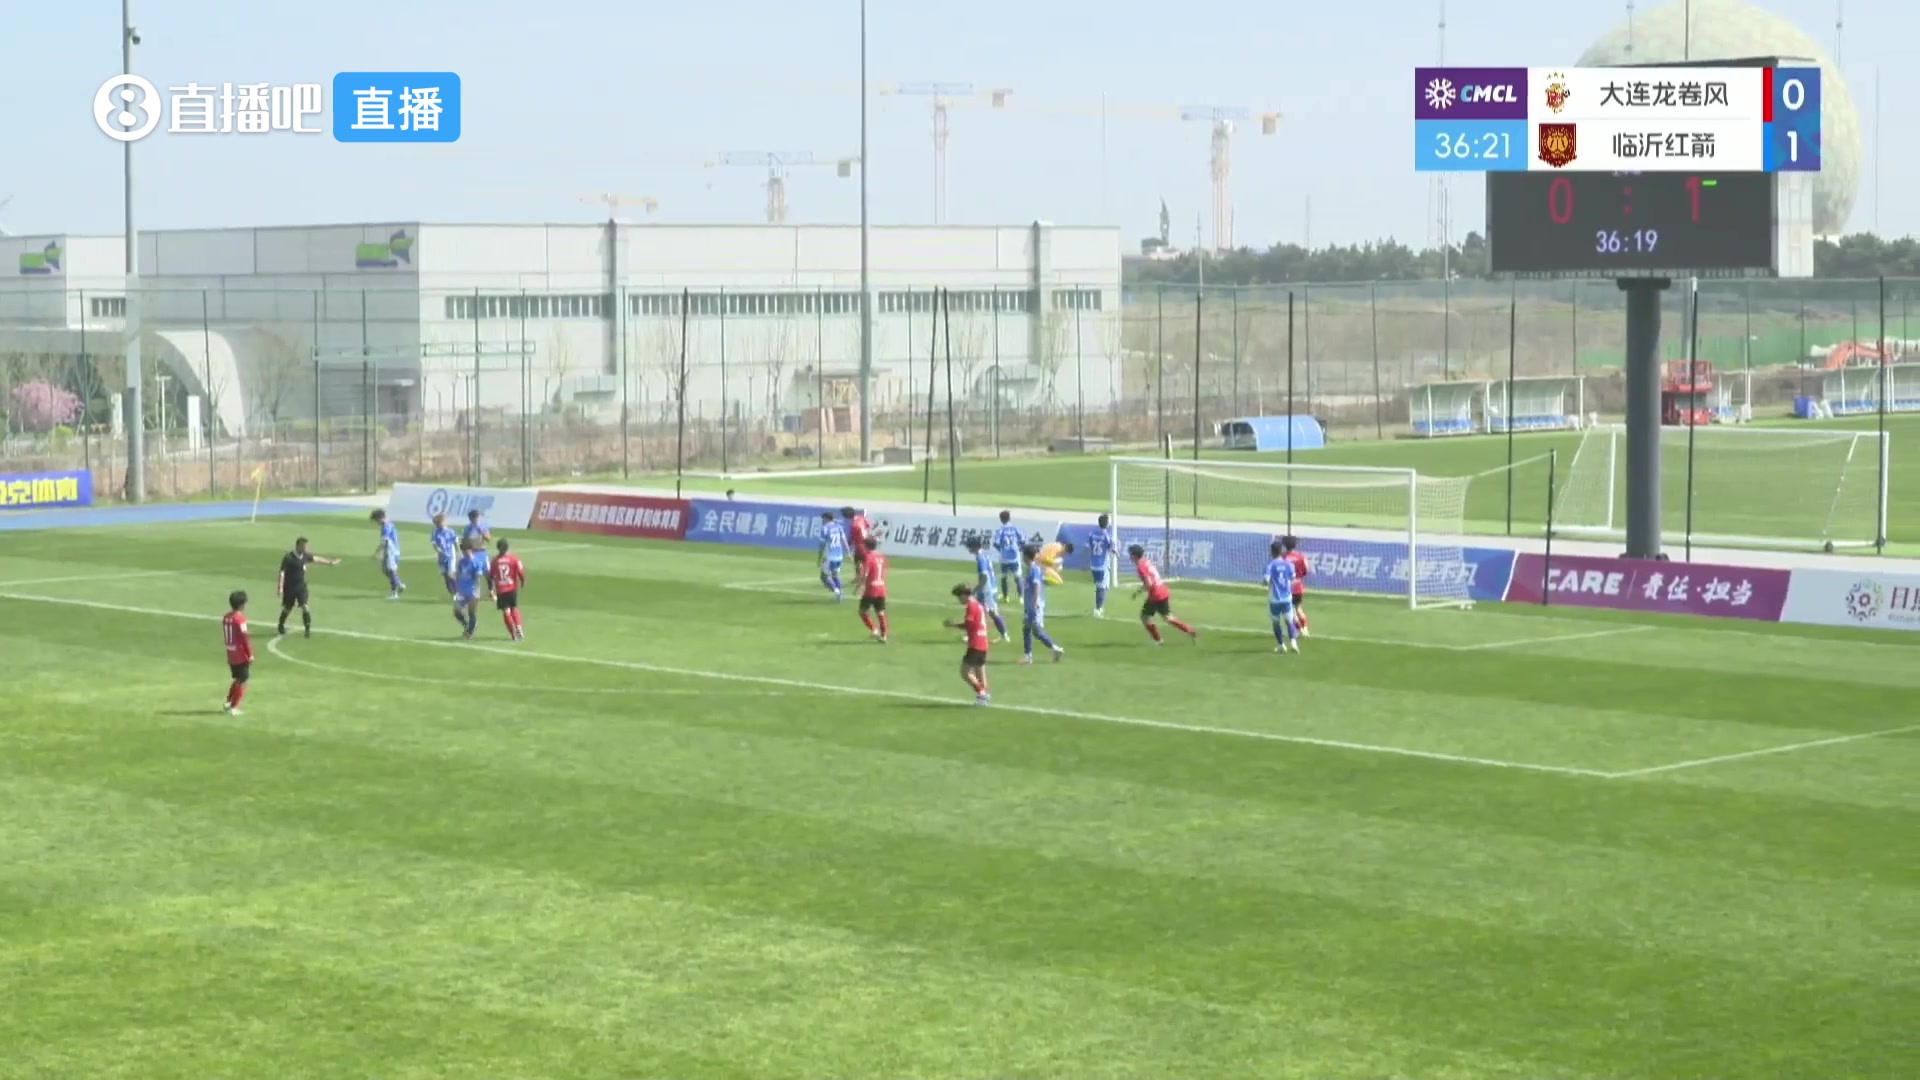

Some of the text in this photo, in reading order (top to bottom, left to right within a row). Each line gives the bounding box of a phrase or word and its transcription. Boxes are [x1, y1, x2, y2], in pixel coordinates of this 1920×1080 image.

[1595, 229, 1658, 253] 36:19
[702, 509, 768, 537] 全民健身
[1541, 568, 1625, 596] CARE
[1890, 587, 1920, 612] 日
[224, 622, 233, 645] 11
